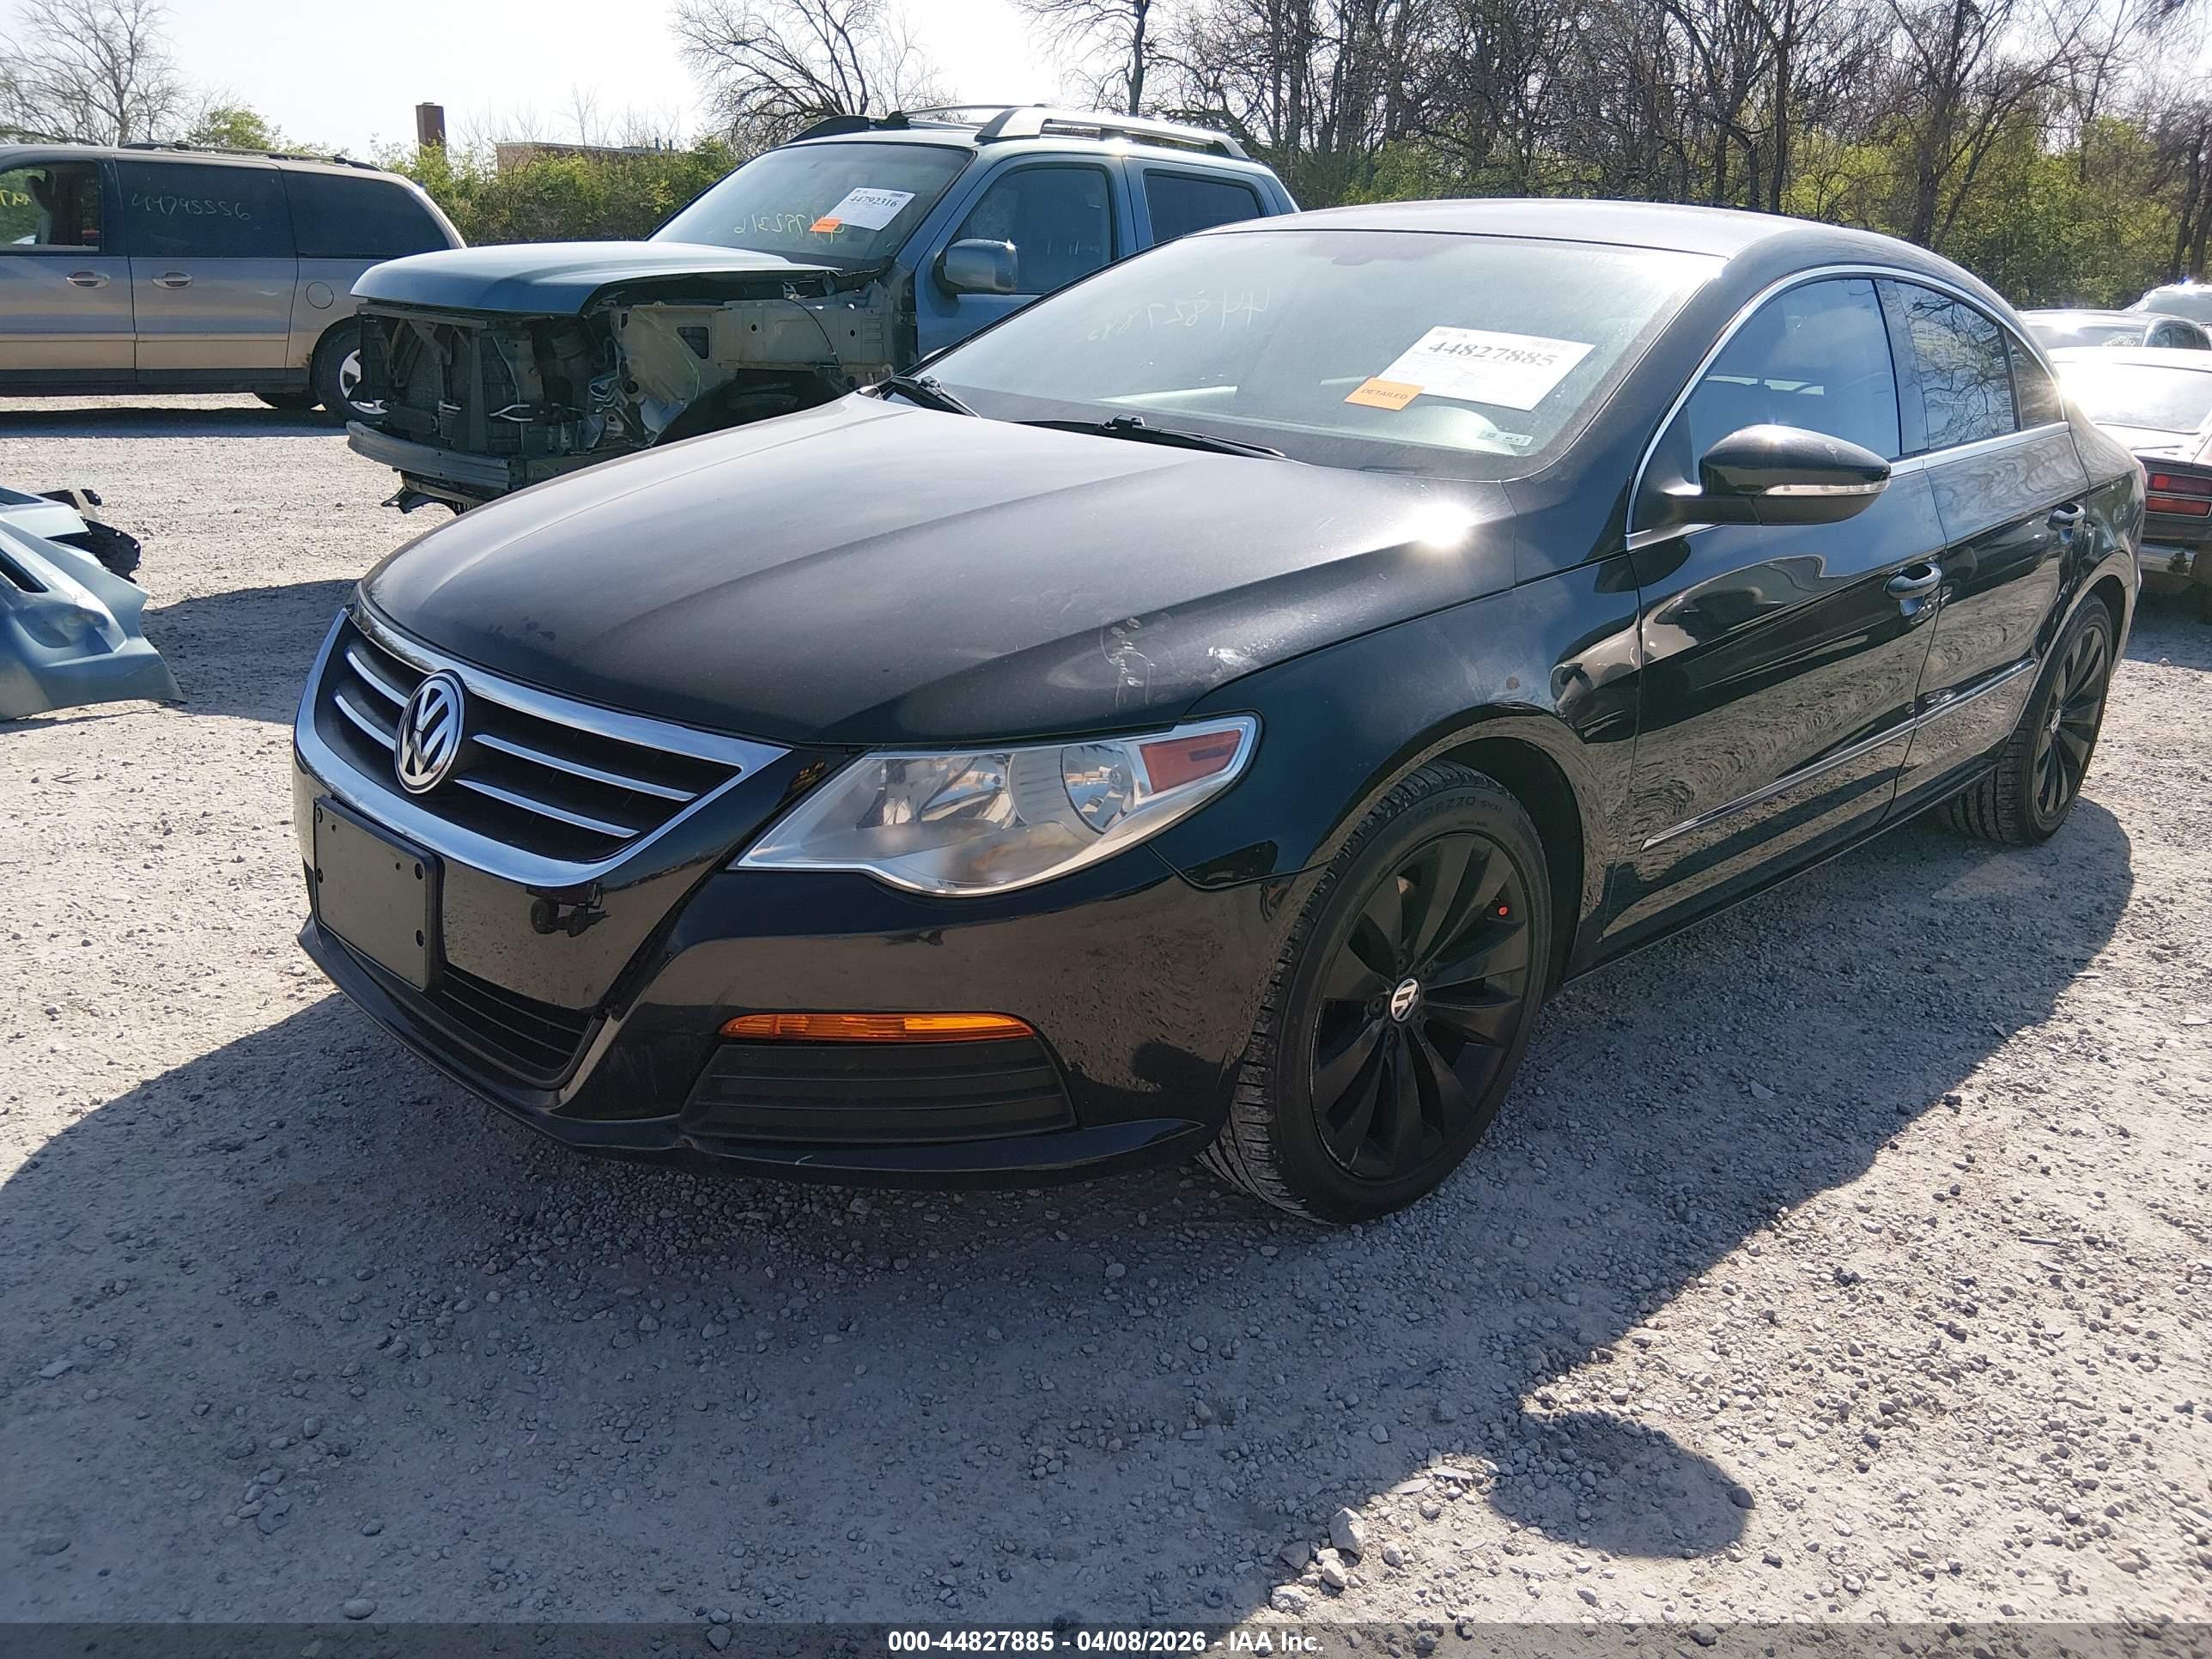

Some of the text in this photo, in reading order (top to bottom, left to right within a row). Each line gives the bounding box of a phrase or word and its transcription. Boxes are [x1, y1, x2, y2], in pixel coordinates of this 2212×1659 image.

[849, 195, 900, 209] 44792316
[1428, 340, 1560, 368] 44827885
[1360, 388, 1409, 400] DETAILED
